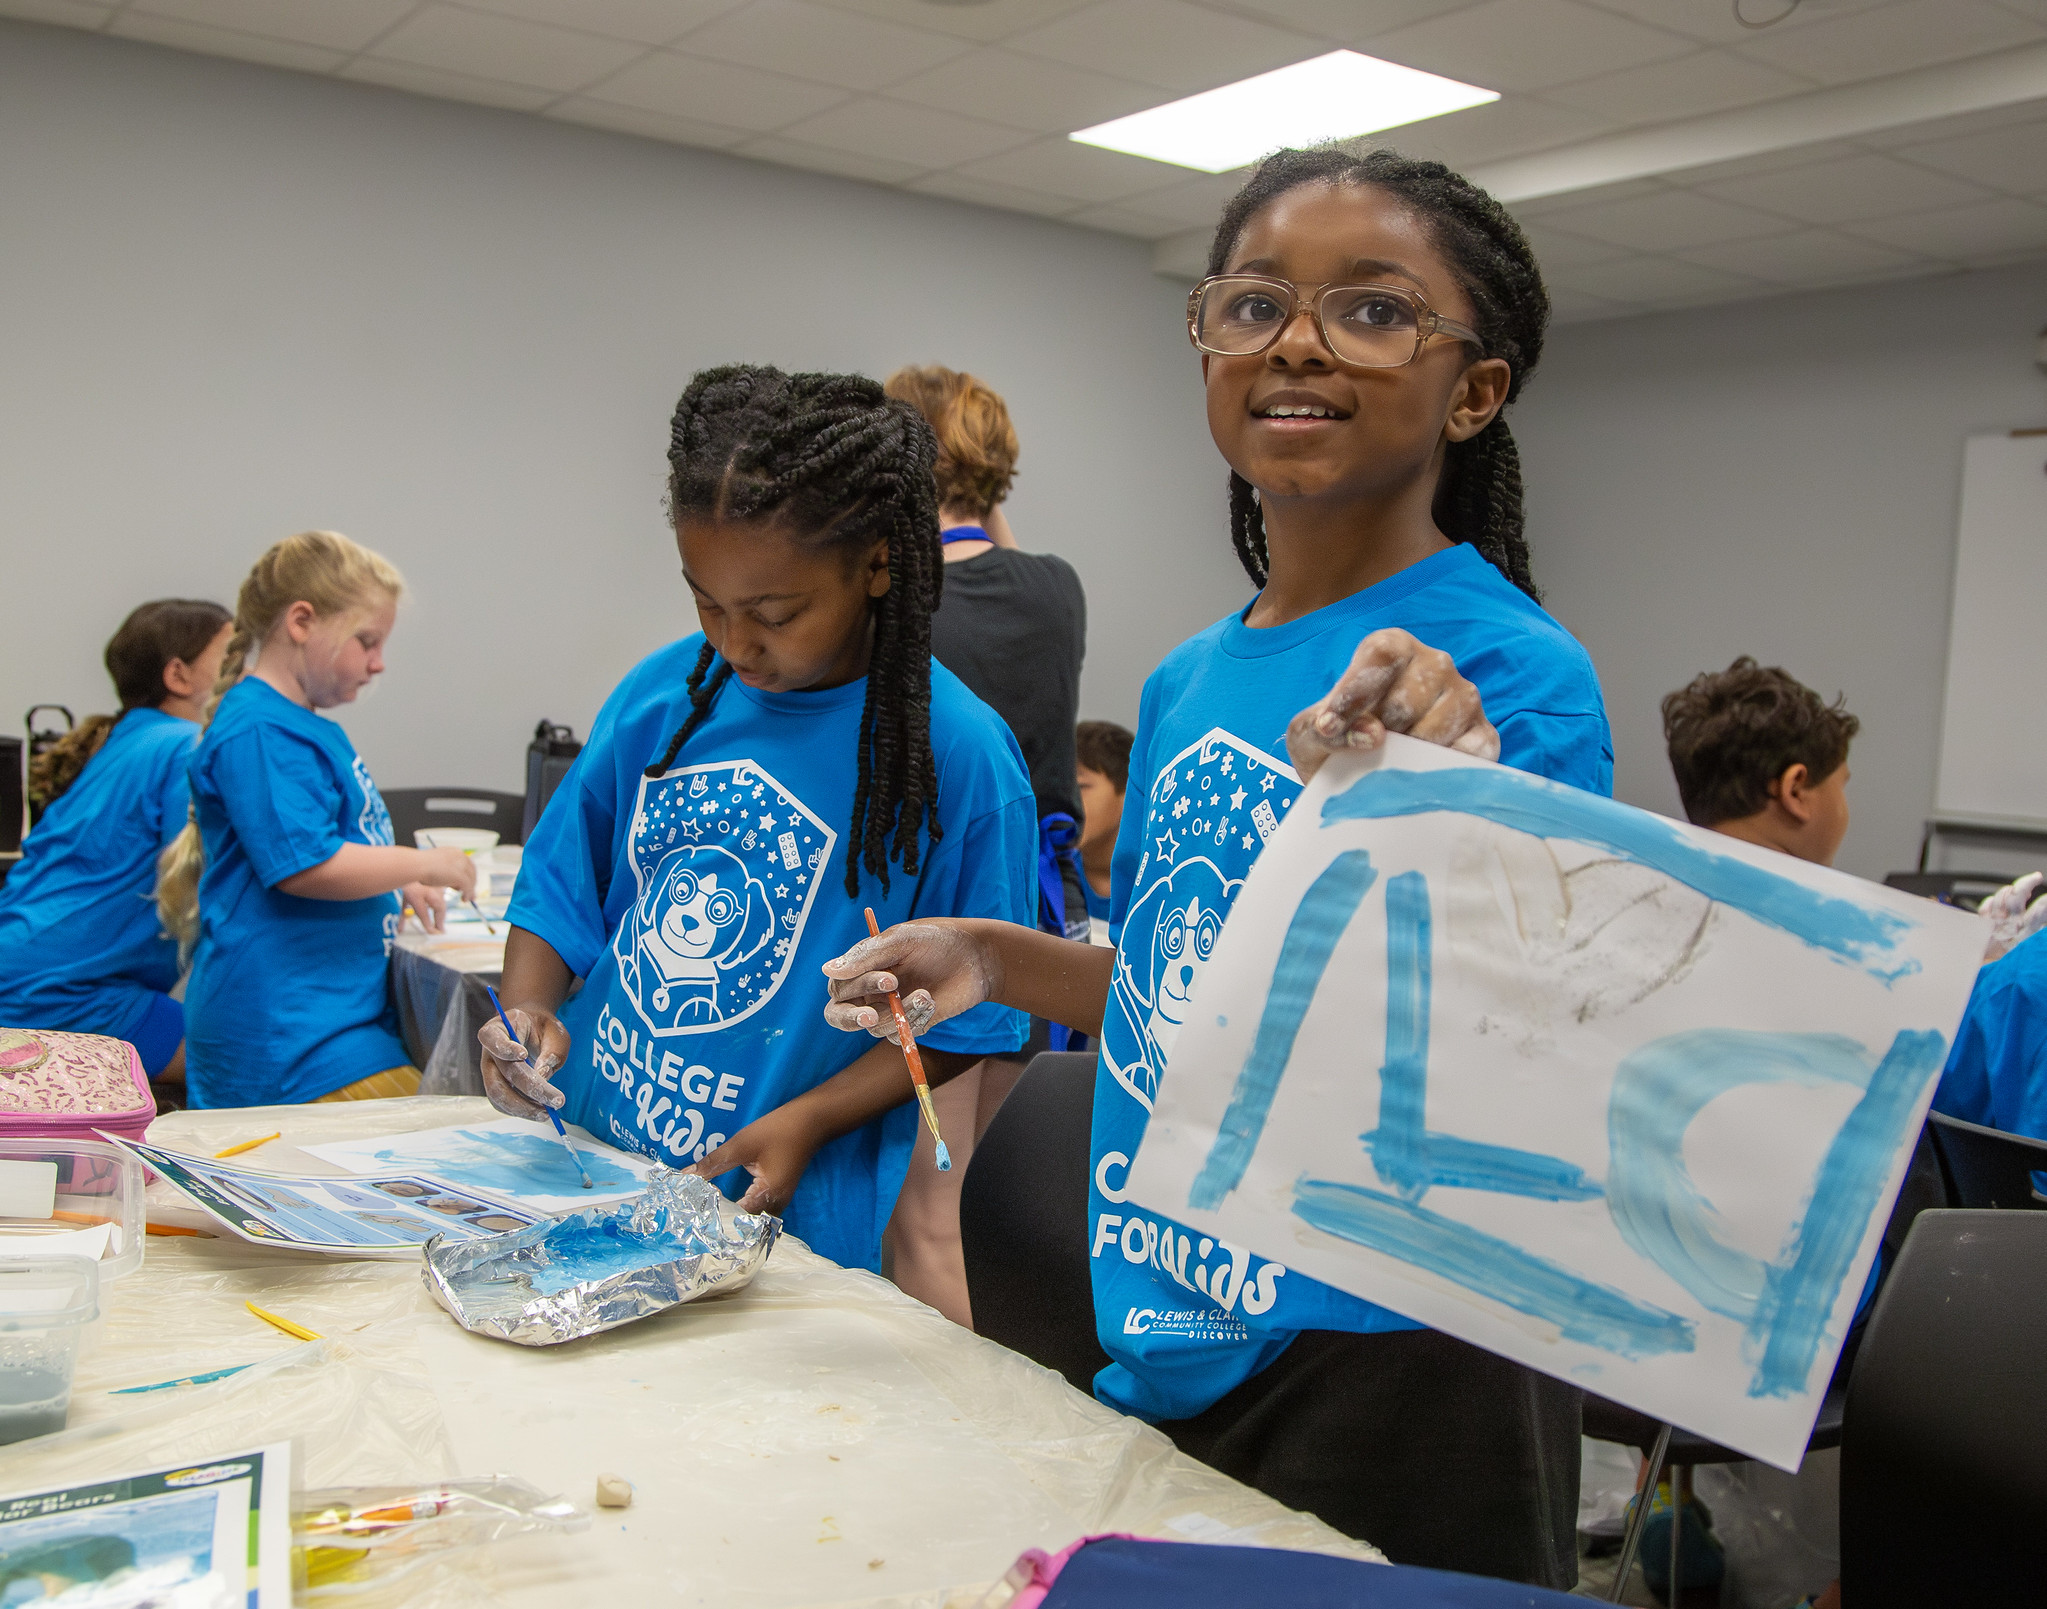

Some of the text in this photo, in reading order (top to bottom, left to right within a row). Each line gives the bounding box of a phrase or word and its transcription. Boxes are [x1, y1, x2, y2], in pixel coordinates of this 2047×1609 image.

[592, 1038, 635, 1100] FOR
[597, 1002, 745, 1112] COLLEGE
[621, 1126, 640, 1148] LEWIS
[1092, 1213, 1161, 1271] FOR
[1123, 1307, 1157, 1335] LC
[1152, 1321, 1247, 1332] COMMUNITY COLLEGE
[1156, 1310, 1196, 1322] LEWIS
[1197, 1309, 1206, 1321] &
[1188, 1330, 1249, 1341] DISCOVER
